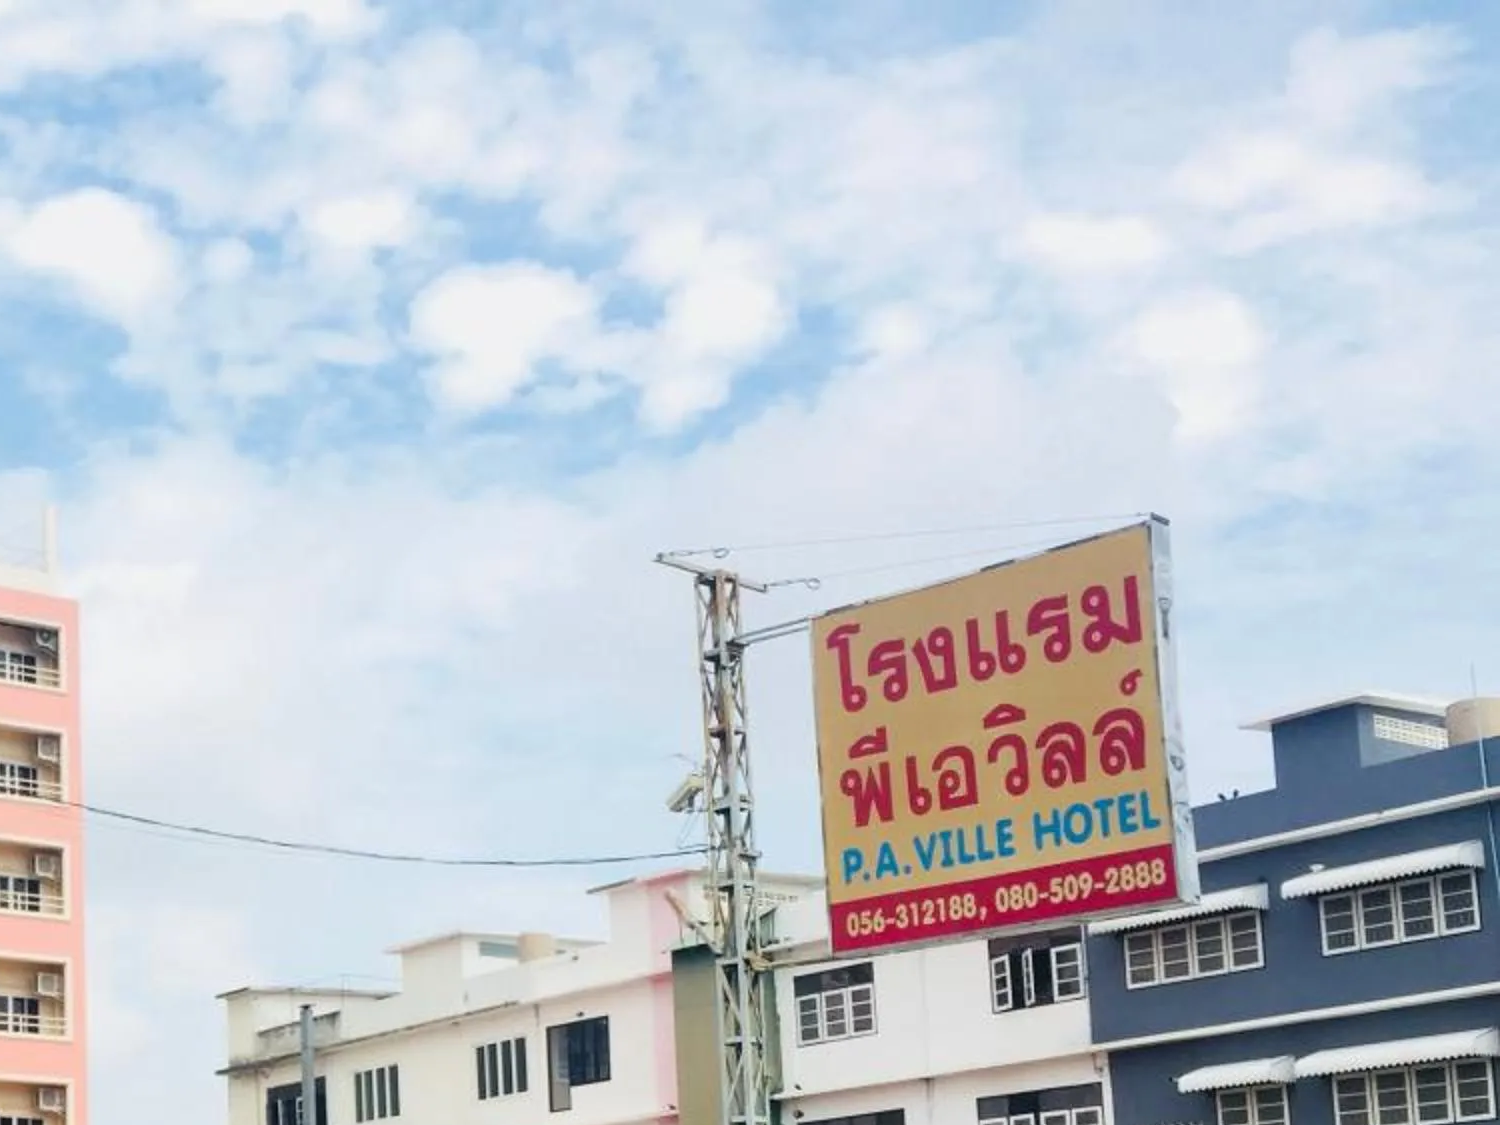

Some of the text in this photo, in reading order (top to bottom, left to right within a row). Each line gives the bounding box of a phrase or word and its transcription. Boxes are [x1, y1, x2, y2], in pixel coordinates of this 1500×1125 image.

[826, 574, 1143, 713] โรงแรม
[840, 668, 1146, 828] พีเอวิลล์
[1032, 789, 1162, 851] HOTEL
[846, 858, 1167, 937] 056-312188, 080-509-2888
